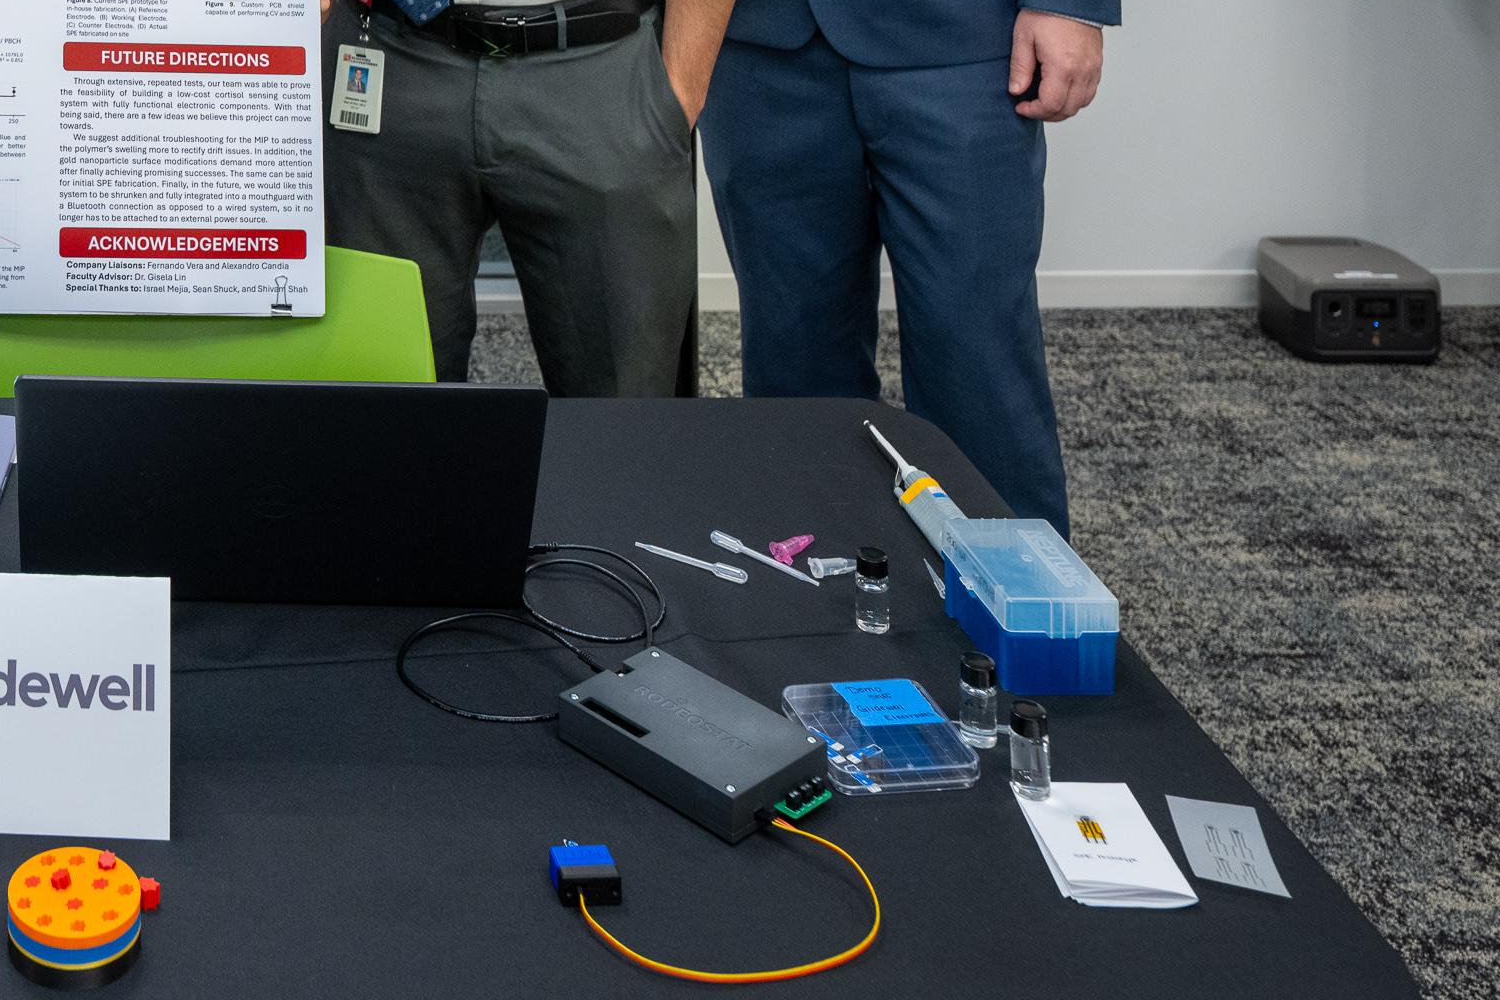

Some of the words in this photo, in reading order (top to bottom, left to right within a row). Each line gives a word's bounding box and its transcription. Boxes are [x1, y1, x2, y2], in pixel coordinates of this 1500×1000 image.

[101, 50, 165, 65] FUTURE
[169, 51, 270, 67] DIRECTIONS
[73, 77, 105, 87] Through
[106, 77, 146, 87] extensive,
[147, 79, 182, 88] repeated
[184, 80, 205, 88] tests,
[222, 80, 242, 88] team
[261, 80, 278, 89] able
[289, 82, 311, 90] prove
[87, 235, 279, 251] ACKNOWLEDGEMENTS
[66, 260, 107, 271] Company
[108, 261, 145, 269] Liaisons:
[147, 261, 185, 270] Fernando
[185, 262, 204, 270] Vera
[204, 262, 220, 270] and
[221, 261, 260, 270] Alexandro
[261, 261, 289, 270] Candia
[66, 272, 97, 282] Faculty
[97, 272, 133, 281] Advisor:
[134, 272, 145, 281] Dr.
[147, 272, 173, 281] Gisela
[174, 273, 186, 281] Lin
[65, 283, 98, 293] Special
[98, 283, 129, 292] Thanks
[143, 284, 166, 293] Israel
[167, 284, 191, 295] Mejia,
[192, 285, 212, 293] Sean
[213, 285, 240, 293] Shuck,
[241, 285, 256, 293] and
[257, 285, 287, 293] Shivam
[288, 285, 308, 293] Shah
[634, 685, 754, 752] RODEOSTAT
